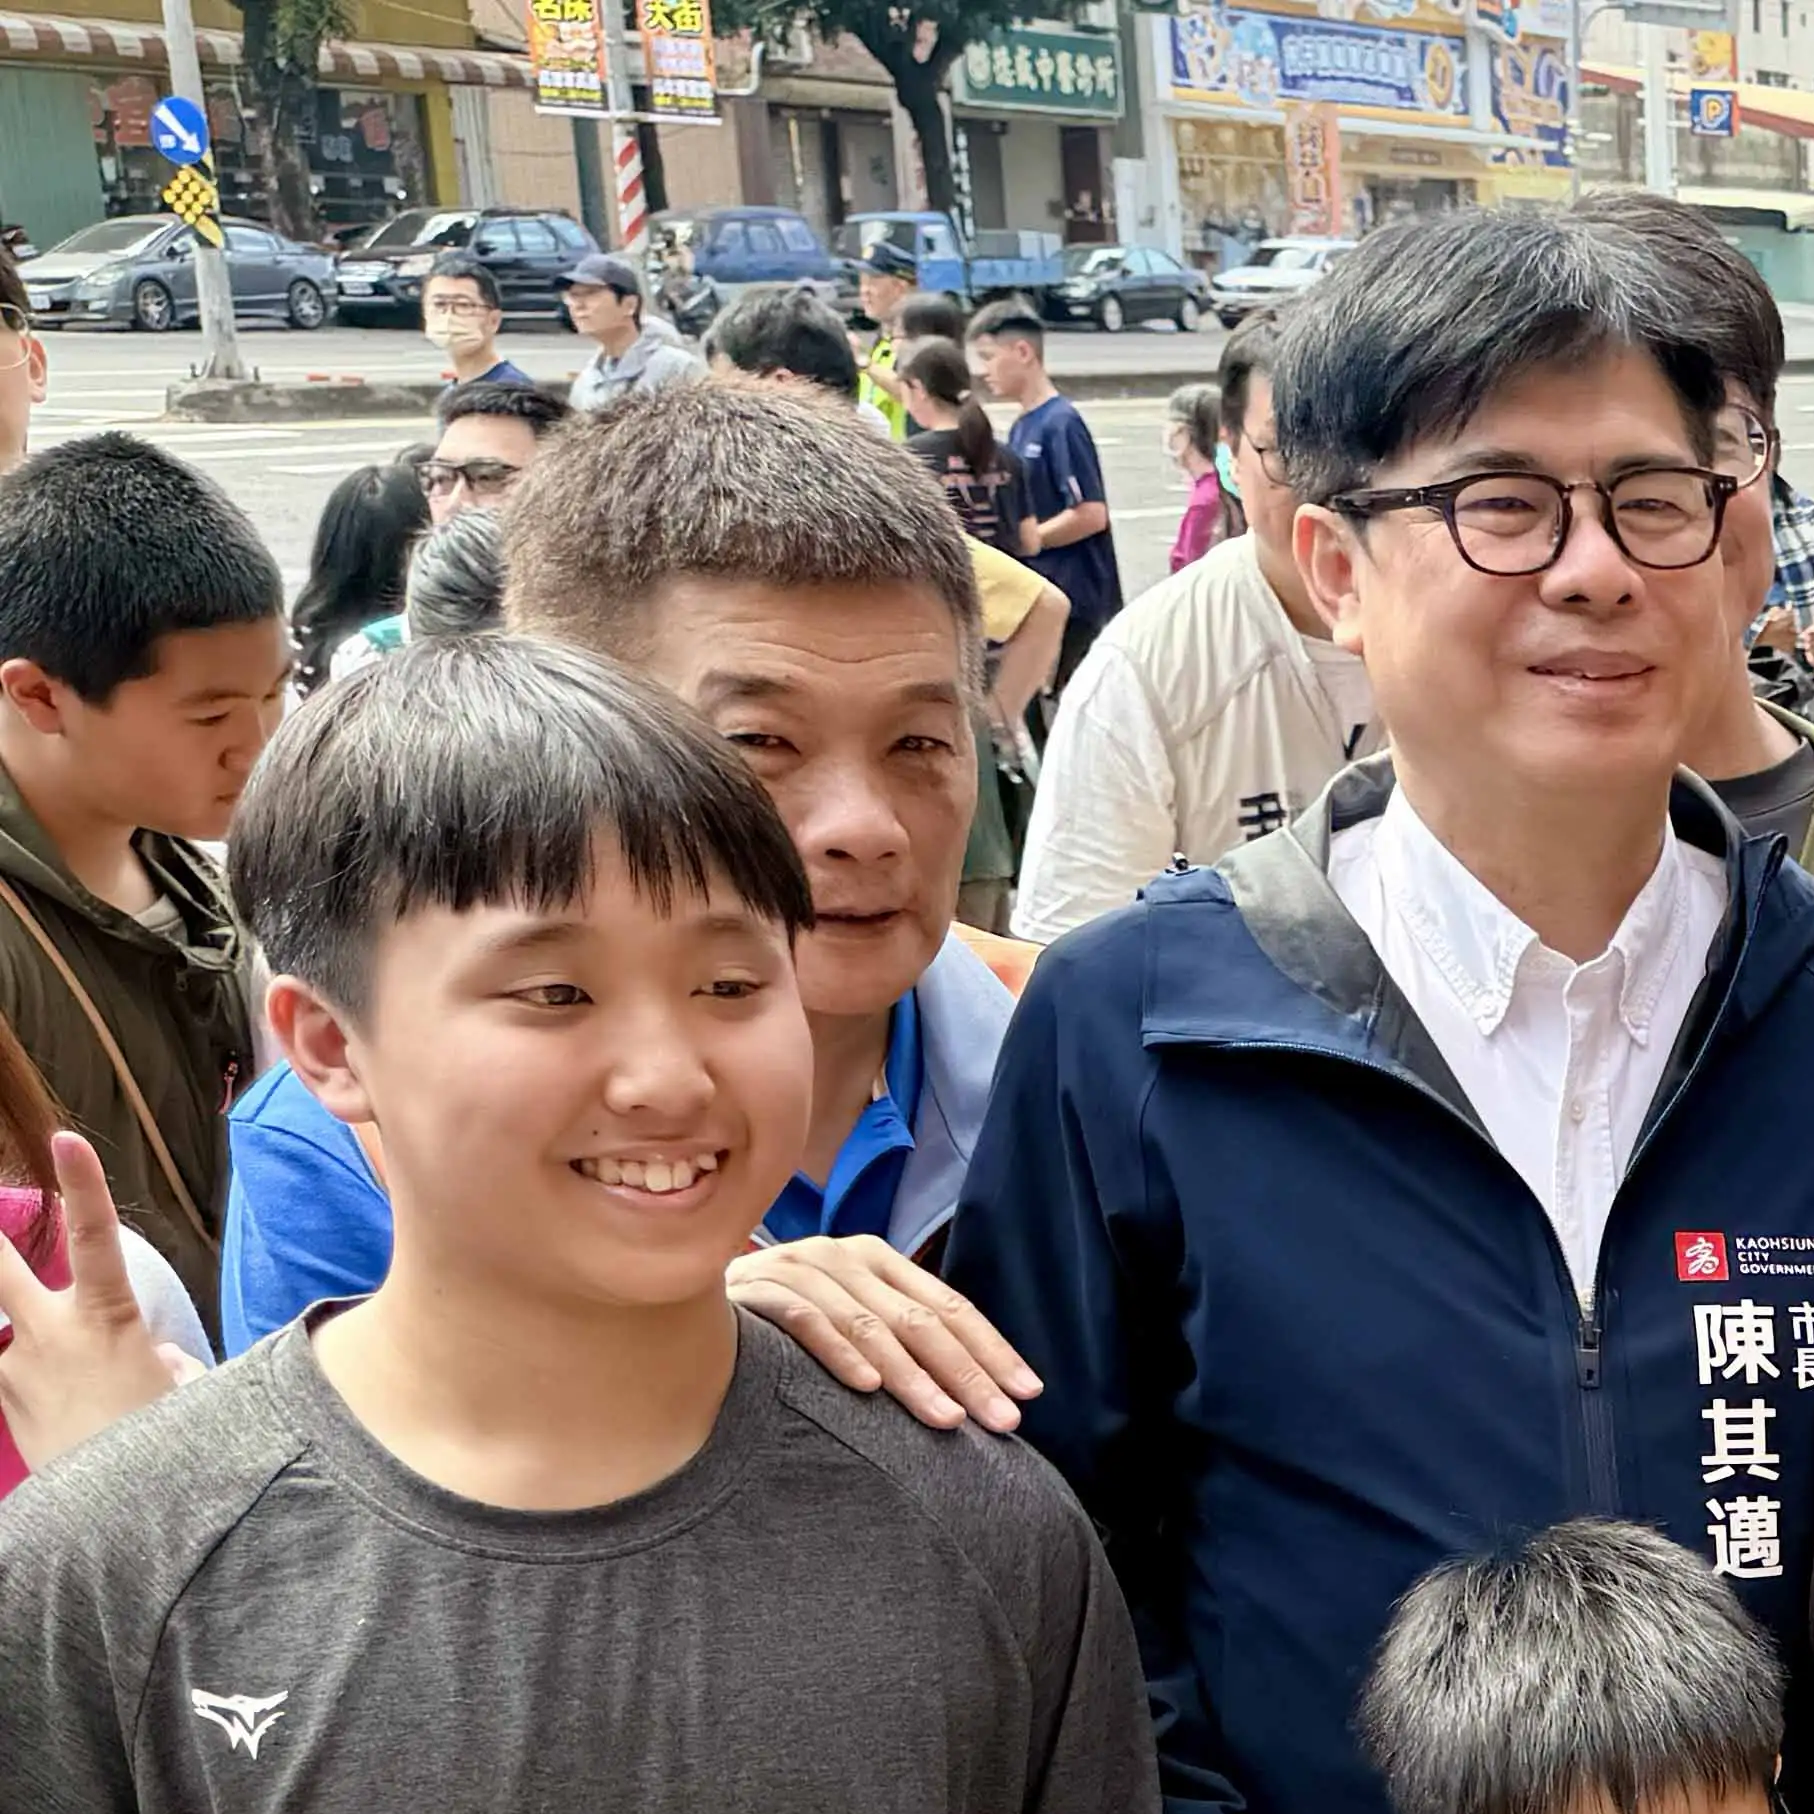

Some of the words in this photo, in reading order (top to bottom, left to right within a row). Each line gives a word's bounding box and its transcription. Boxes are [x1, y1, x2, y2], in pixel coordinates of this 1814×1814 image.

[1738, 1251, 1770, 1263] CITY
[1692, 1298, 1783, 1579] 陳其邁
